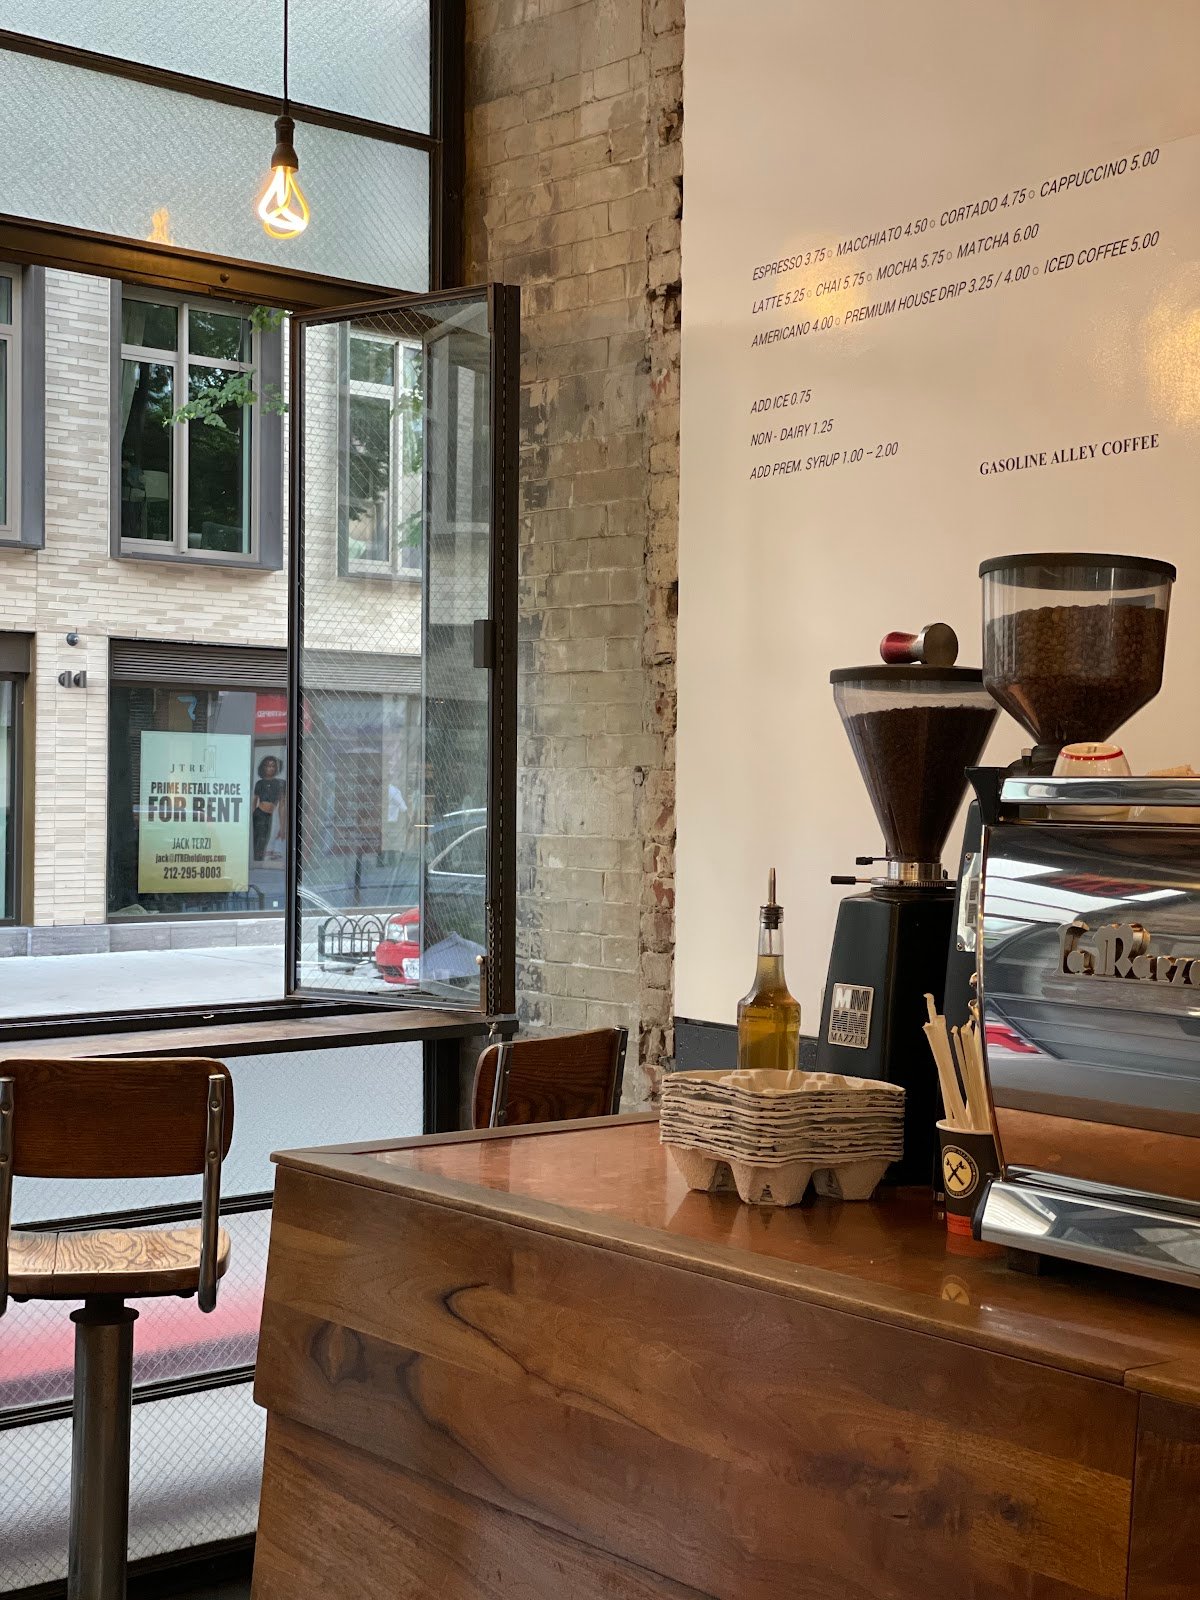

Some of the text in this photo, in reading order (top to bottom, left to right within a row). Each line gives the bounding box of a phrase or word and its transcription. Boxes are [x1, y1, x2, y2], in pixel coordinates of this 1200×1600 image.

[752, 149, 1160, 281] ESPRESSO 3.75 MACCHIATO 4.50 CORTADO 4.75 CAPPUCCINO 5.00
[752, 223, 1039, 314] LATTE 5.25 CHAI 5.75 MOCHA 5.75 MATCHA 6.00
[751, 321, 811, 348] AMERICANO
[812, 315, 834, 332] 4.00
[844, 299, 897, 325] PREMIUM
[897, 287, 938, 311] HOUSE
[938, 281, 967, 301] DRIP
[968, 273, 994, 293] 3.25
[1003, 264, 1031, 284] 4.00
[1043, 253, 1075, 274] ICED
[1077, 238, 1130, 266] COFFEE
[1130, 230, 1160, 252] 5.00
[750, 389, 812, 414] ADD ICE 0.75
[750, 430, 773, 447] NON
[779, 423, 812, 441] DAIRY
[813, 418, 834, 435] 1.25
[750, 464, 771, 480] ADD
[772, 459, 803, 476] PREM.
[805, 452, 840, 470] SYRUP
[842, 447, 864, 464] 1.00
[875, 441, 899, 459] 2.00
[979, 433, 1160, 476] GASOLINE ALLEY COFFEE
[150, 781, 241, 796] PRIME RETAIL SPACE
[147, 795, 243, 823] FOR RENT
[172, 837, 212, 850] JACK TERZI
[163, 866, 222, 880] 212-295-8003
